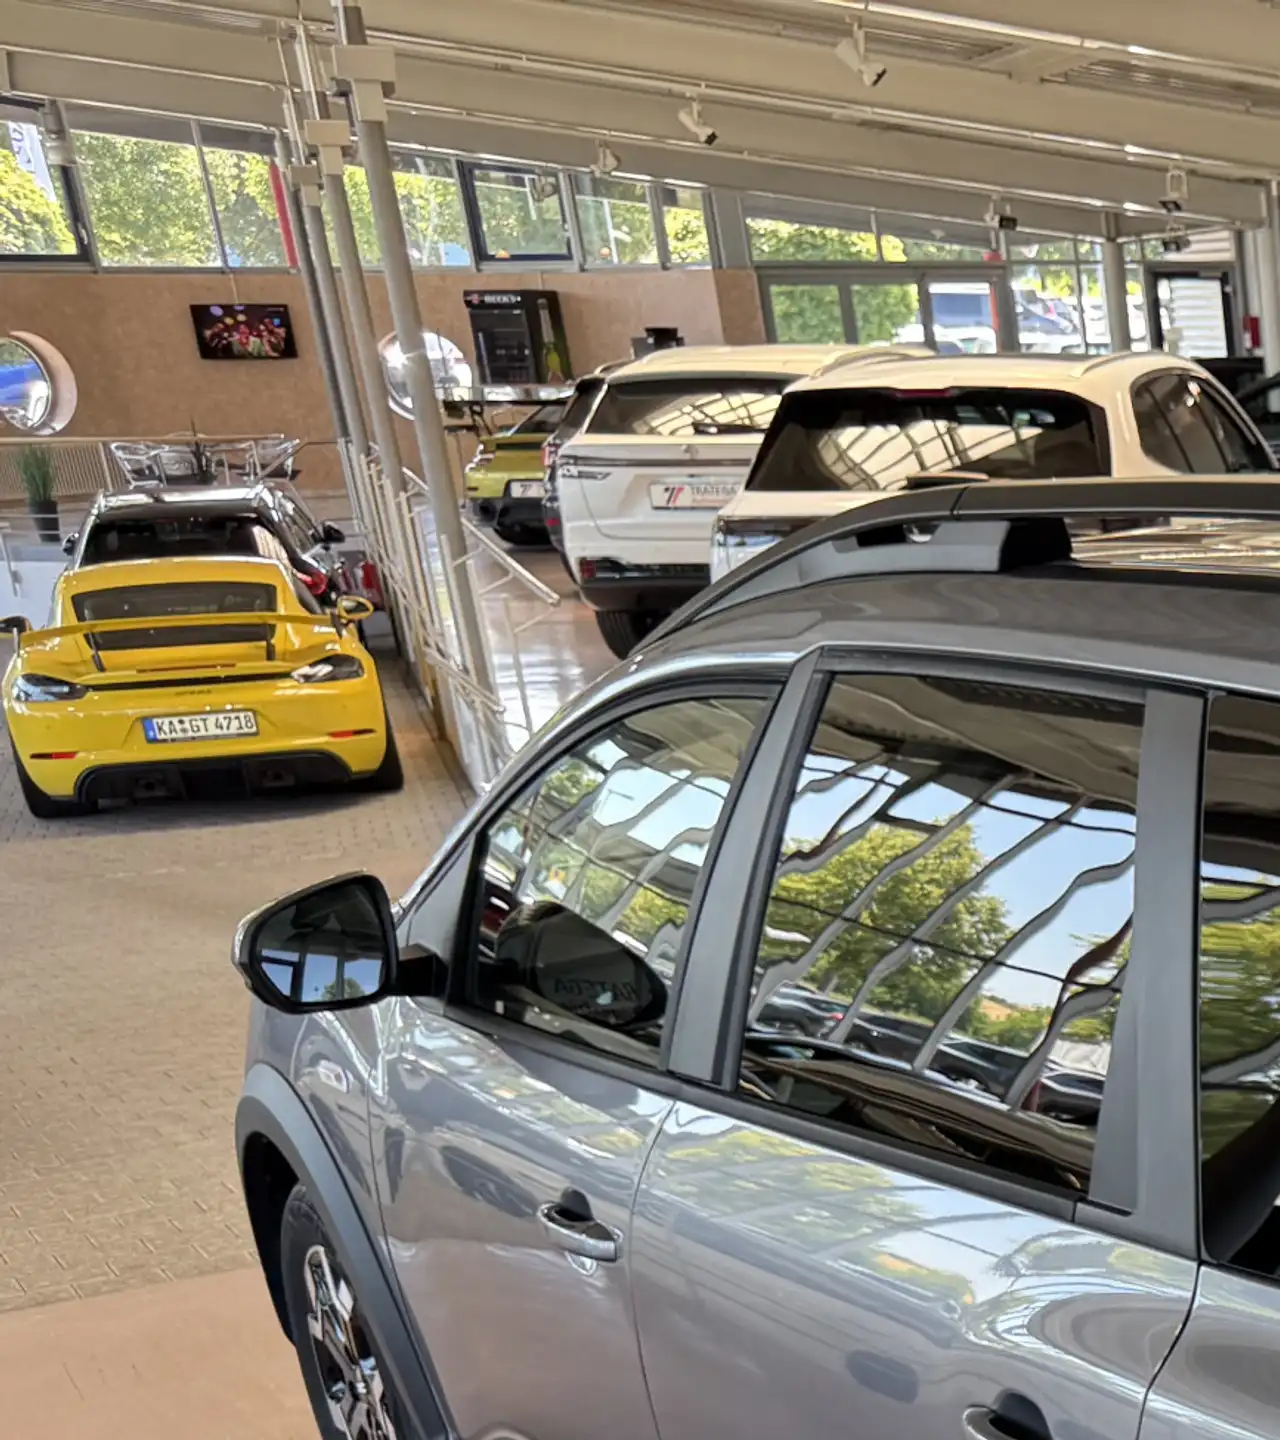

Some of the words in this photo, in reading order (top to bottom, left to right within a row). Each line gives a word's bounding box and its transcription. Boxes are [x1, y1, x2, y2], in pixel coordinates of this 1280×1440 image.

[155, 719, 178, 737] KA
[188, 717, 210, 734] GT
[214, 714, 254, 731] 4718
